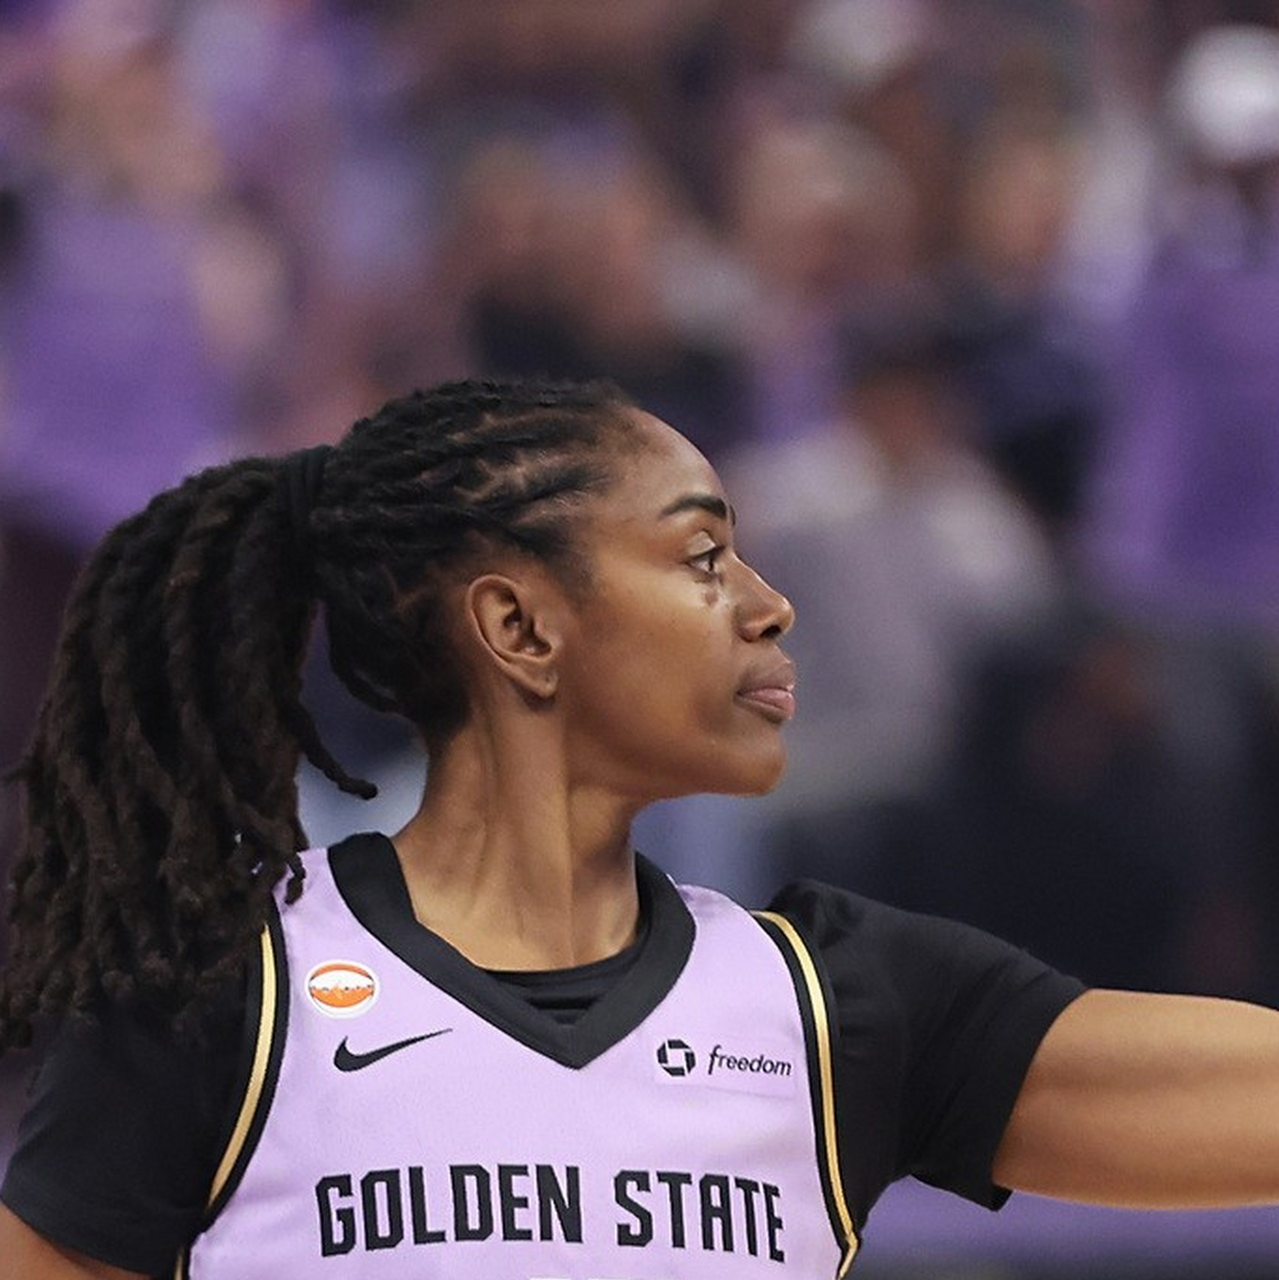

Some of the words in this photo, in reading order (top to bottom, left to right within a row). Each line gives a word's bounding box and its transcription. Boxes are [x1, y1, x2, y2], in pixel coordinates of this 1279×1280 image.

[707, 1044, 793, 1077] freedom
[315, 1163, 583, 1258] GOLDEN
[613, 1169, 786, 1263] STATE
